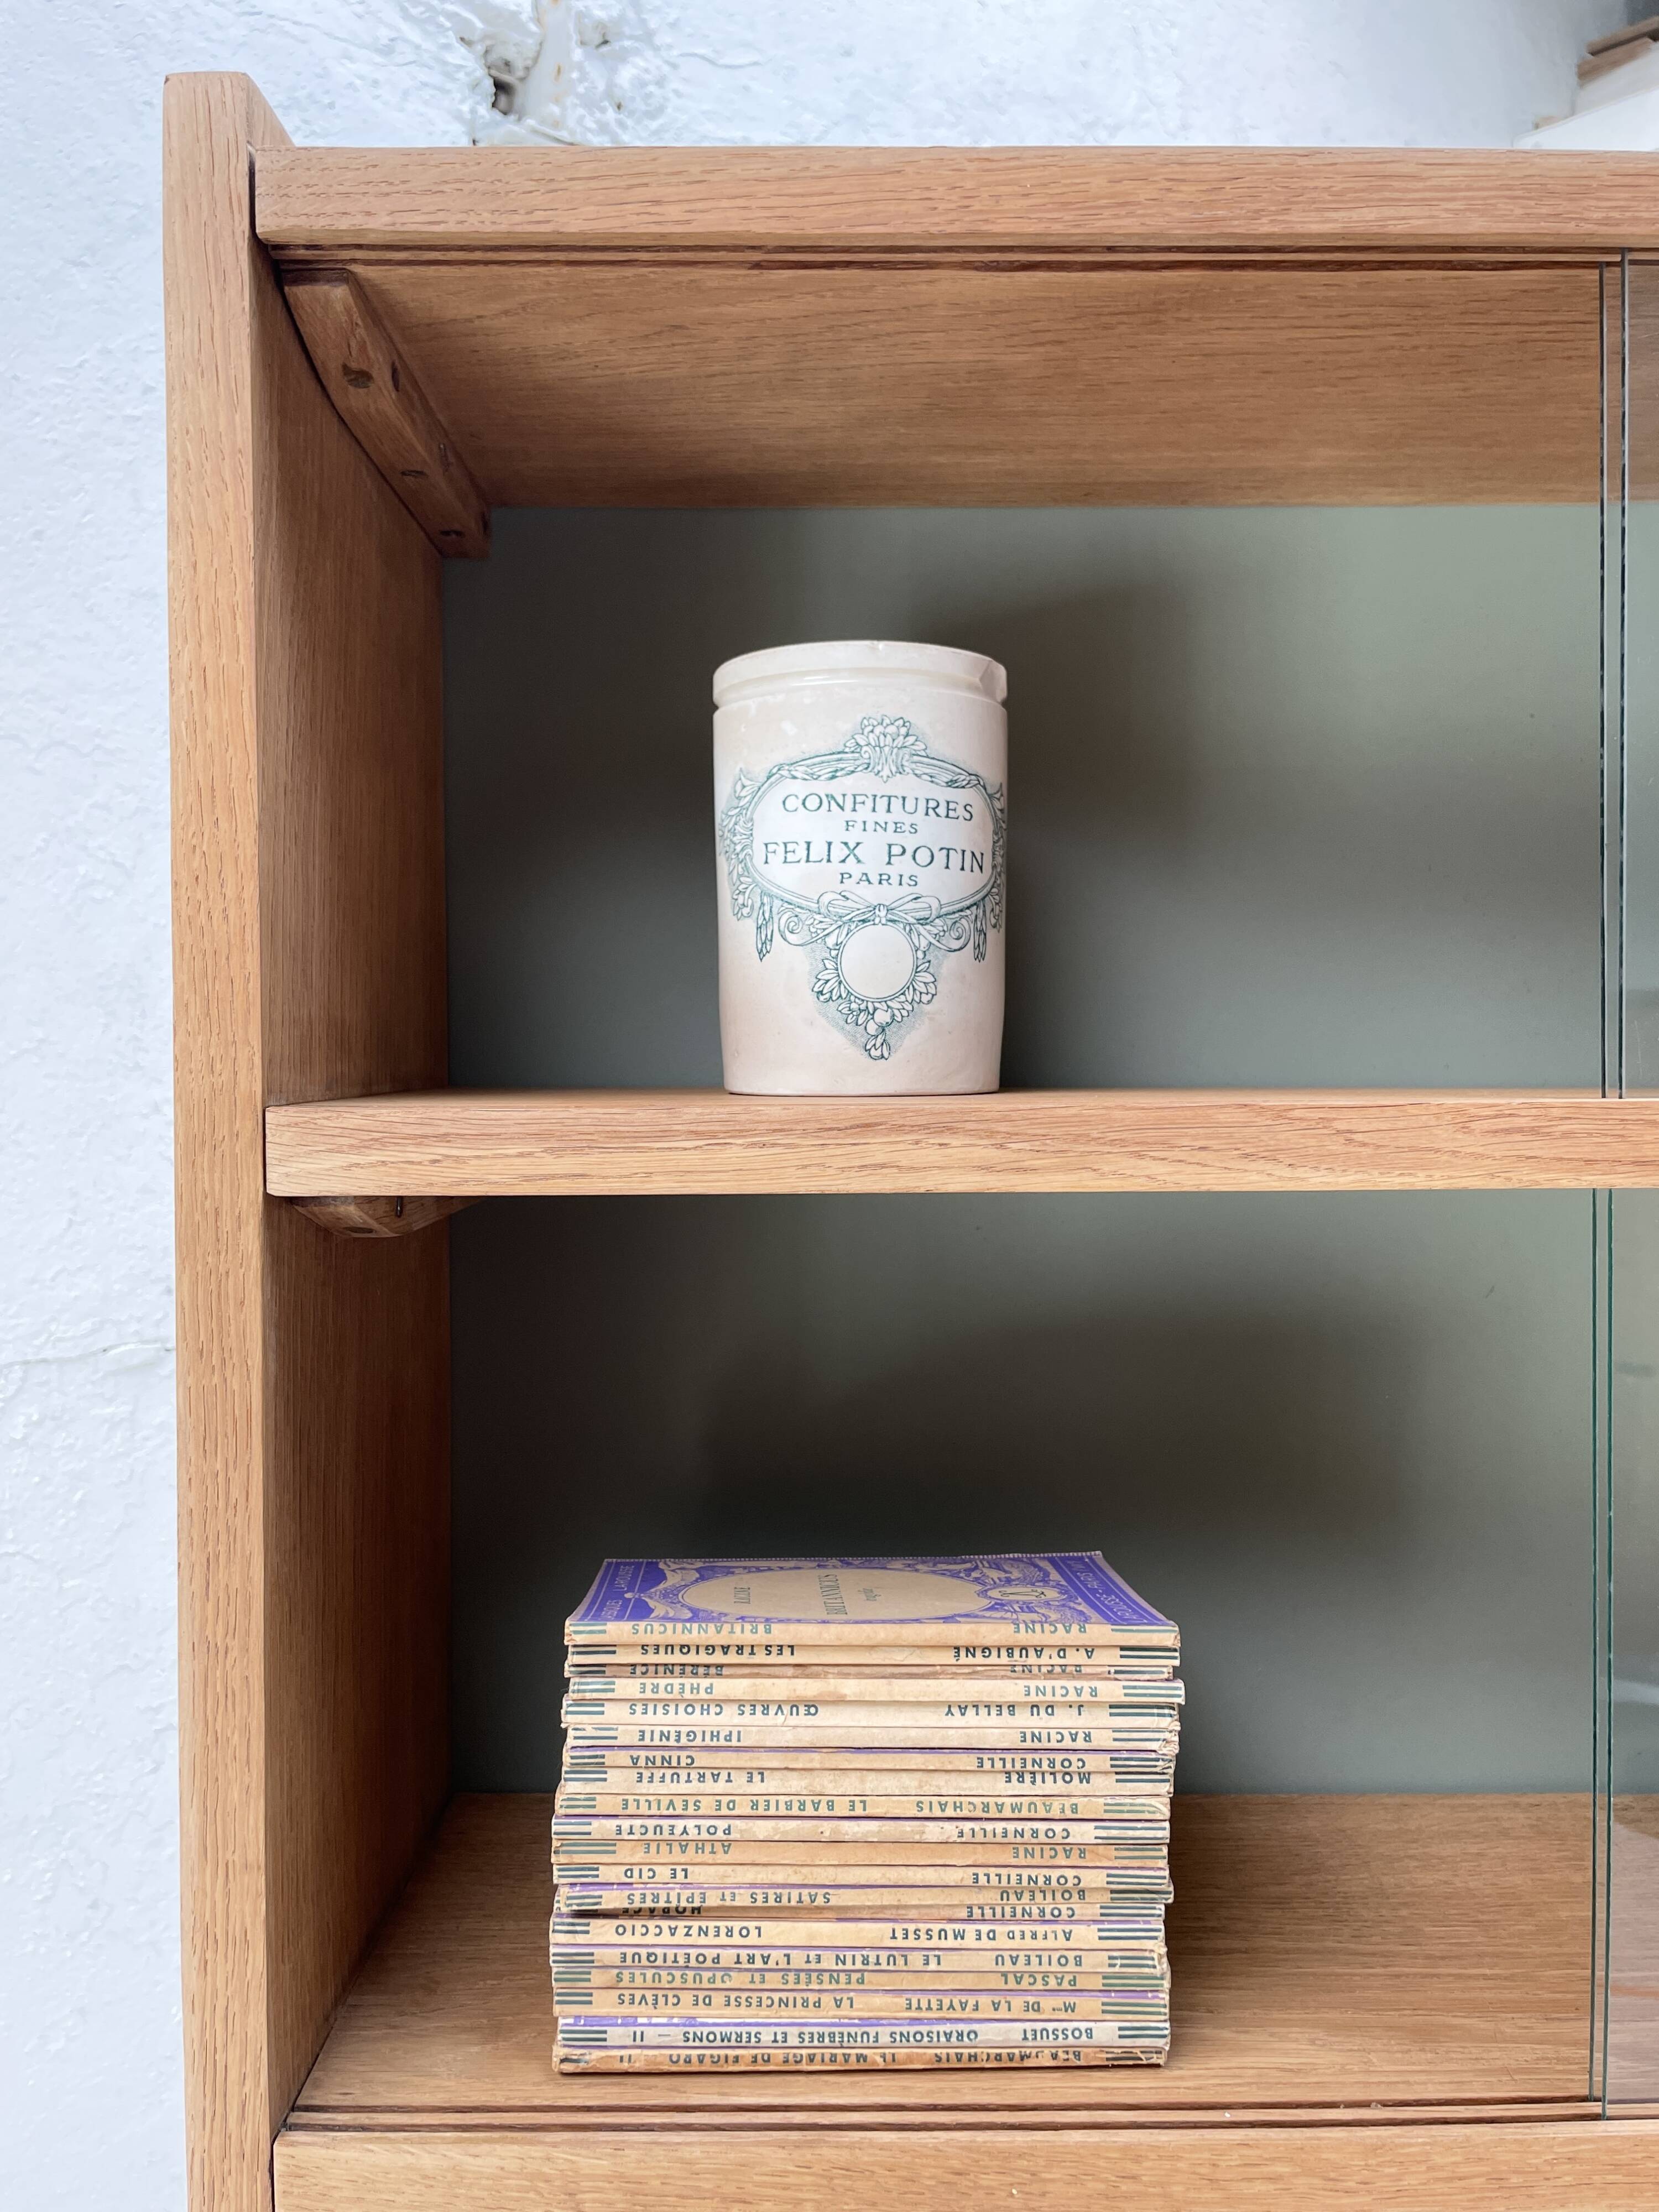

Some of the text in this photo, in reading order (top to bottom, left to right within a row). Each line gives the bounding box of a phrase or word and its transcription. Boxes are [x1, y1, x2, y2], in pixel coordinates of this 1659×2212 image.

[782, 794, 973, 822] CONFITURES
[845, 821, 919, 834] FINES
[763, 841, 984, 874] FELIX POTIN
[839, 873, 919, 886] PARIS
[818, 1574, 848, 1615] BRITANNICUS
[631, 1623, 771, 1635] BRITANNICUS
[1013, 1623, 1086, 1634] RACINE
[641, 1644, 794, 1656] LES TRAGIQUES
[953, 1646, 1094, 1661] A. D'AUBIGNÉ
[630, 1663, 724, 1678] BÉRÉNICE
[1010, 1665, 1082, 1673] RACINE
[639, 1682, 713, 1698] PHÈDRE
[1024, 1685, 1097, 1698] RACINE
[629, 1703, 818, 1716] ŒUVRES CHOISIES
[945, 1704, 1084, 1717] J. DU BELLAY
[1020, 1731, 1091, 1743] RACINE
[630, 1755, 695, 1766] CINNA
[977, 1757, 1086, 1768] CORNEILLE
[636, 1771, 764, 1783] LE TARTUFFE
[1004, 1772, 1090, 1786] MOLIÈRE
[715, 1799, 735, 1811] DE
[750, 1799, 834, 1812] BARBIER
[849, 1799, 866, 1812] LE
[916, 1801, 1078, 1814] BEAUMARCHAIS
[615, 1824, 731, 1836] POLYEUCTE
[957, 1828, 1070, 1840] CORNEILLE
[644, 1842, 732, 1855] ATHALIE
[1012, 1847, 1086, 1859] RACINE
[624, 1867, 688, 1879] LE CID
[972, 1872, 1081, 1886] CORNEILLE
[720, 1892, 735, 1901] ET
[749, 1892, 830, 1903] SATIRES
[1000, 1889, 1086, 1901] BOILEAU
[966, 1906, 1075, 1918] CORNEILLE
[614, 1924, 761, 1938] LORENZACCIO
[889, 1928, 1072, 1941] ALFRED DE MUSSET
[619, 1952, 940, 1967] LE LUTRIN ET L'ART POÉTIQUE
[995, 1954, 1082, 1966] BOILEAU
[615, 1971, 864, 1986] PENSÉES ET OPUSCULES
[1000, 1973, 1076, 1986] PASCAL
[617, 1993, 854, 2009] LA PRINCESSE DE CLÈVES
[905, 1998, 979, 2011] FAYETTE
[992, 2000, 1011, 2012] LA
[1024, 2001, 1040, 2012] DE
[633, 2031, 644, 2042] II
[682, 2031, 761, 2043] SERMONS
[771, 2031, 787, 2043] ET
[798, 2031, 879, 2047] FUNÈBRES
[889, 2029, 978, 2043] ORAISONS
[1021, 2027, 1093, 2041] BOSSUET
[782, 2053, 868, 2063] MARIAGE
